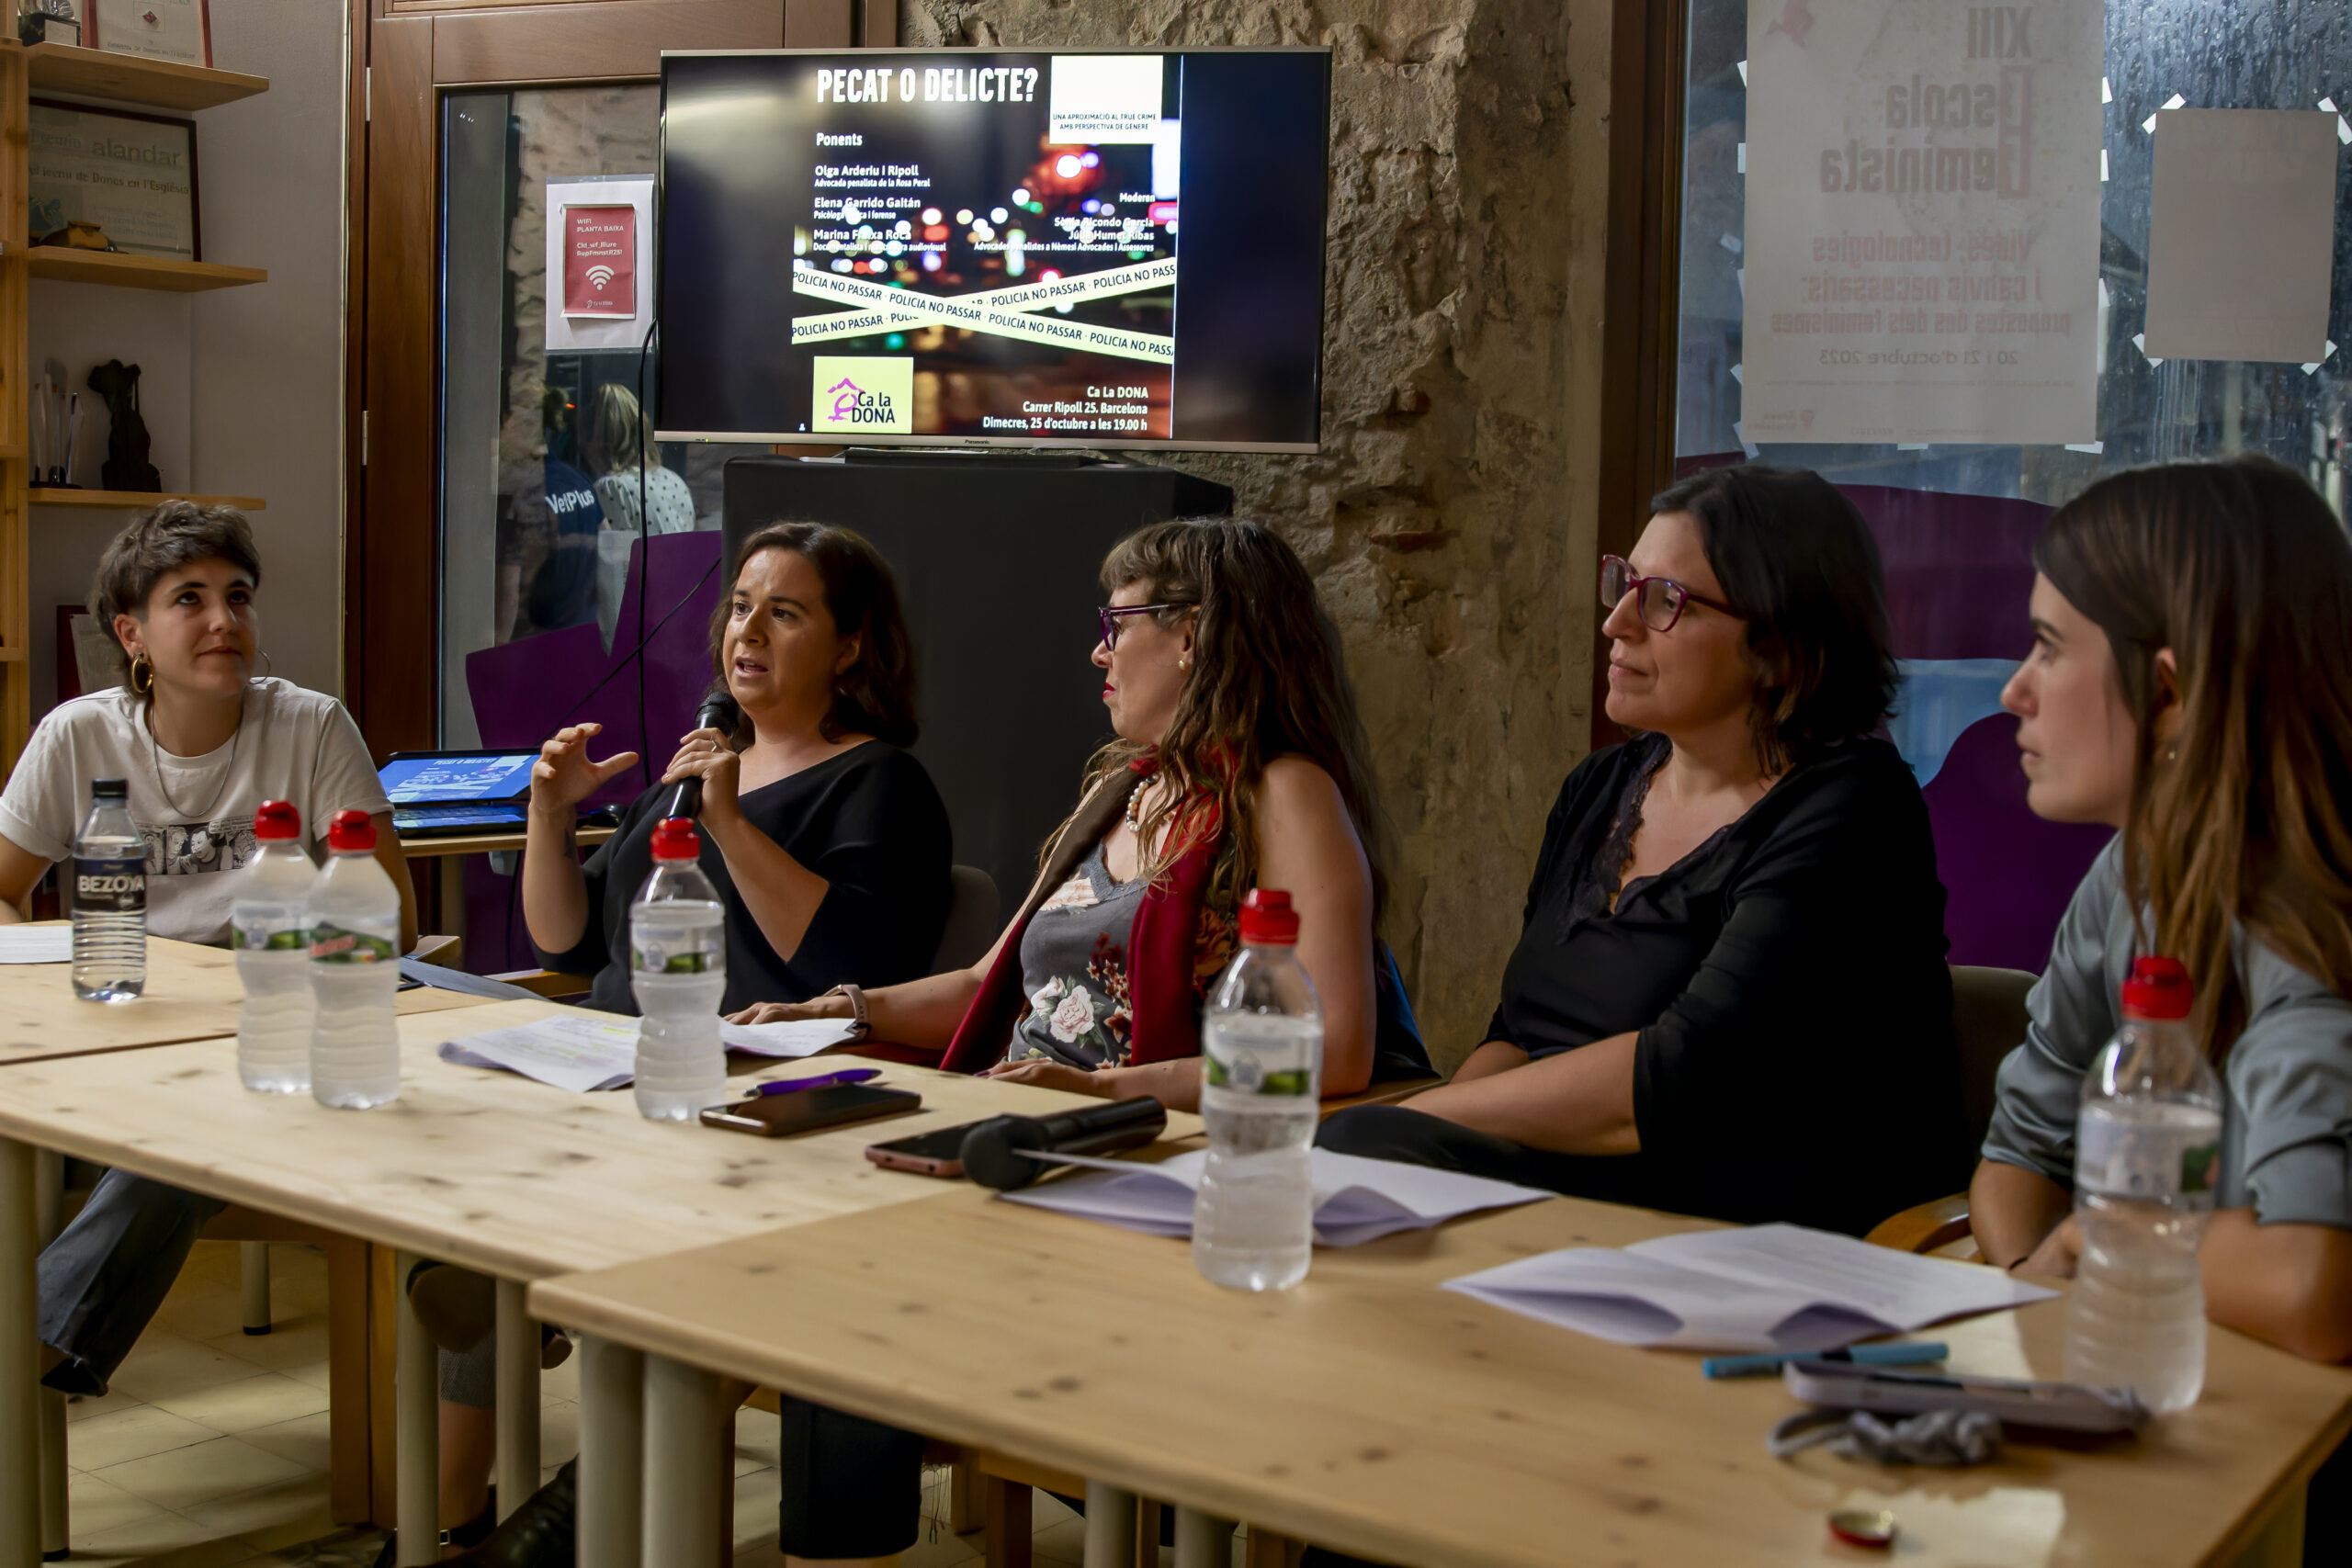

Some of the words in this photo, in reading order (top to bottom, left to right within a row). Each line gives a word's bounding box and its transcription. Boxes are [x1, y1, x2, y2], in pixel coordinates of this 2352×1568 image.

[817, 68, 893, 103] PECAT
[899, 68, 917, 103] O
[924, 67, 1039, 103] DELICTE?
[816, 132, 863, 146] Ponents
[91, 137, 182, 167] alandar
[815, 165, 839, 178] Olga
[842, 165, 879, 175] Arderiu
[888, 164, 919, 179] Ripoll
[92, 173, 124, 186] Dones
[128, 179, 140, 188] en
[814, 178, 847, 187] Advocada
[847, 178, 877, 189] penalista
[878, 178, 887, 187] de
[888, 178, 895, 187] la
[896, 178, 911, 187] Rosa
[814, 197, 842, 208] Elena
[845, 197, 884, 208] Garrido
[887, 197, 921, 208] Gaitán
[1119, 192, 1156, 203] Moderen
[872, 210, 896, 220] forense
[813, 230, 850, 240] Marina
[1128, 231, 1155, 241] Ribas
[909, 243, 946, 252] audiovisual
[1078, 243, 1113, 252] Advocades
[1118, 243, 1155, 252] Assessores
[991, 292, 1029, 307] POLICIA
[1033, 288, 1046, 299] NO
[1050, 282, 1085, 297] PASSAR
[1093, 273, 1131, 288] POLICIA
[1135, 270, 1150, 282] NO
[793, 271, 828, 288] POLICIA
[831, 280, 845, 292] NO
[847, 284, 882, 300] PASSAR
[889, 293, 926, 310] POLICIA
[929, 301, 944, 313] NO
[946, 305, 981, 321] PASSAR
[989, 313, 1025, 330] POLICIA
[1029, 322, 1045, 333] NO
[1046, 326, 1081, 340] PASSAR
[1090, 333, 1127, 349] POLICIA
[1131, 340, 1146, 351] NO
[792, 321, 829, 337] POLICIA
[831, 321, 845, 332] NO
[849, 315, 883, 329] PASSAR
[857, 391, 874, 407] Ca
[879, 392, 890, 407] la
[1087, 386, 1101, 398] Ca
[1102, 386, 1114, 398] La
[1117, 387, 1148, 399] DONA
[1023, 401, 1053, 412] Carrer
[1055, 401, 1082, 415] Ripoll
[1101, 402, 1148, 414] Barcelona
[852, 408, 895, 423] DONA
[983, 416, 1028, 430] Dimecres,
[1030, 417, 1042, 429] 25
[1044, 417, 1088, 430] d'octubre
[1090, 421, 1096, 430] a
[1098, 418, 1112, 430] les
[1114, 419, 1138, 430] 19.00
[1141, 419, 1148, 430] h
[77, 874, 144, 893] BEZOYA
